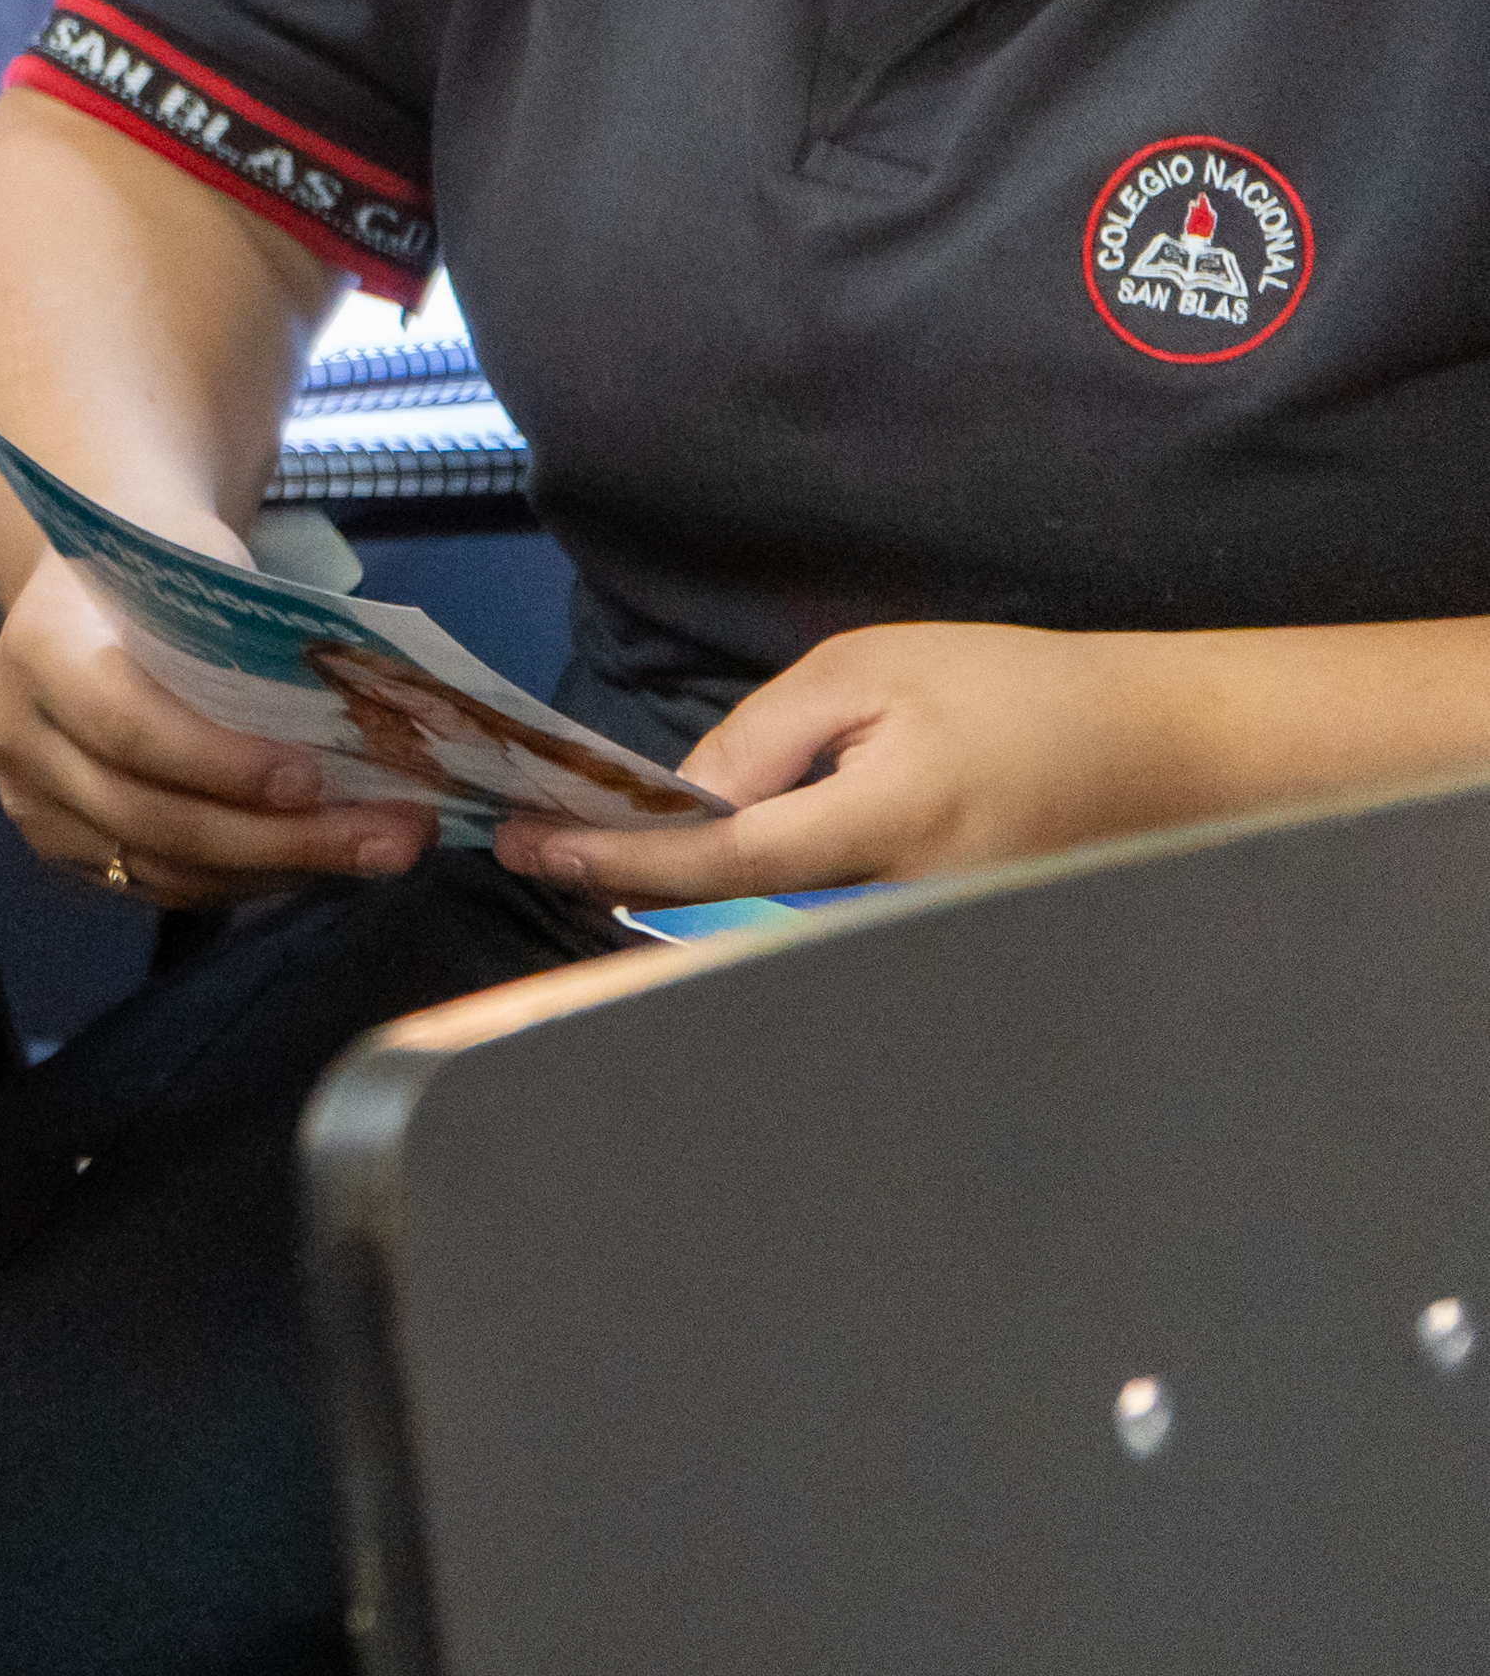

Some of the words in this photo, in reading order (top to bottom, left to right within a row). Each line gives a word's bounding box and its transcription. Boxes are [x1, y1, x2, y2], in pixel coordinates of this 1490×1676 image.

[50, 17, 154, 99] SAN
[159, 82, 342, 213] BLAS
[1097, 155, 1194, 271] COLEGIO
[1203, 154, 1296, 293] NACIONAL
[1117, 277, 1171, 312] SAN
[1178, 290, 1249, 325] BLAS
